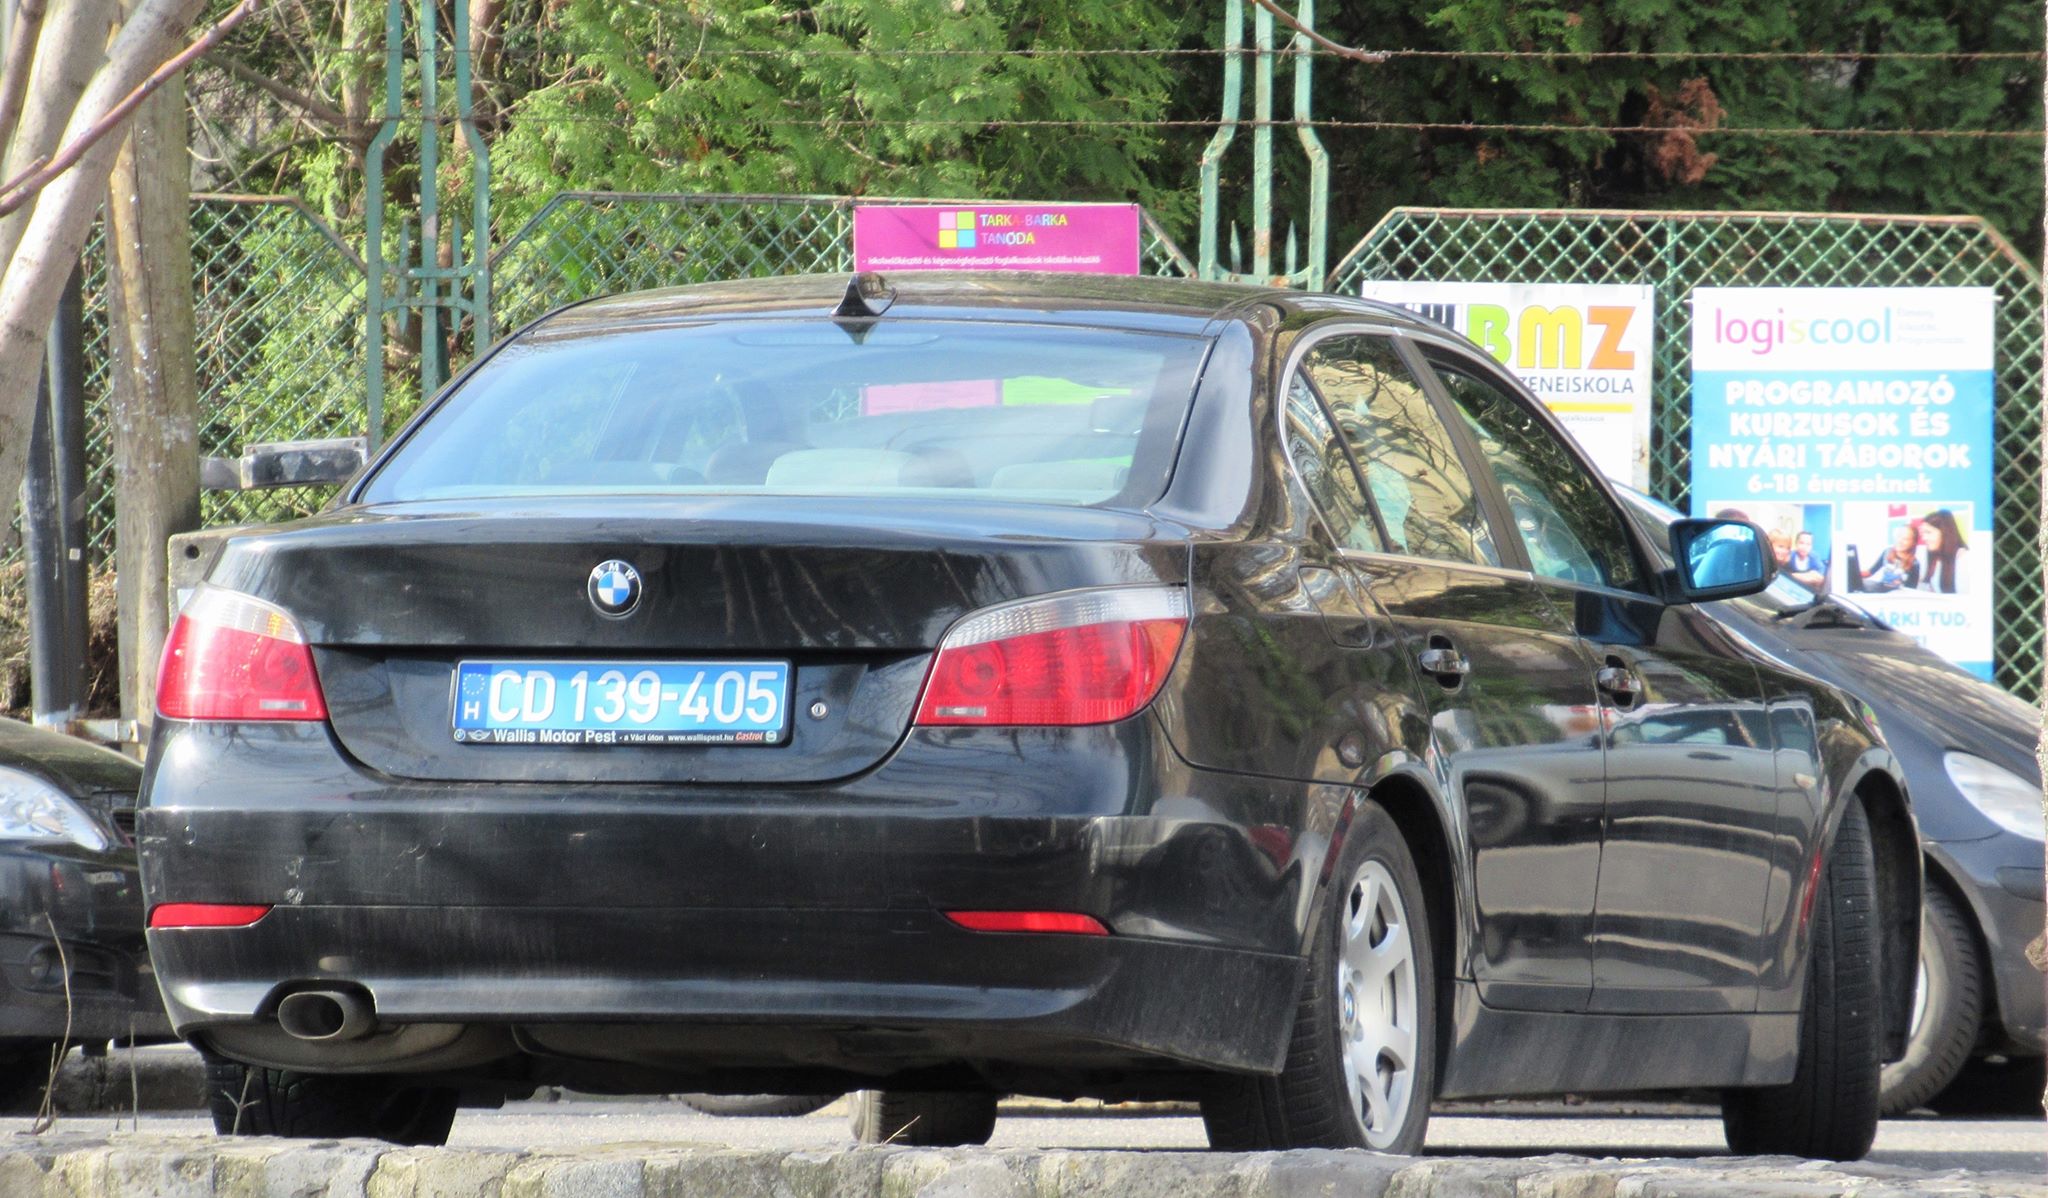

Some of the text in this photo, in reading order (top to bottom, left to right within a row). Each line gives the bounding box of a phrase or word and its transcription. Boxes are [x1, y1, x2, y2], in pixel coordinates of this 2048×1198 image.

[980, 232, 1036, 246] TANODA
[1466, 303, 1637, 370] BMZ
[1714, 306, 1891, 355] logiscool
[1725, 375, 1956, 406] PROGRAMOZÓ
[1729, 407, 1951, 437] KURZUSOK ÉS
[1708, 438, 1972, 469] NYÁRI TÁBOROK
[1747, 473, 1934, 494] 6-18 éveseknek
[592, 562, 636, 579] BMW
[463, 701, 480, 721] H
[489, 670, 779, 724] CD 139-405
[493, 729, 536, 742] Wallis
[540, 730, 581, 742] Motor
[585, 730, 617, 743] Pest
[668, 733, 735, 743] www.wallispest.hu
[735, 731, 763, 741] Castrol
